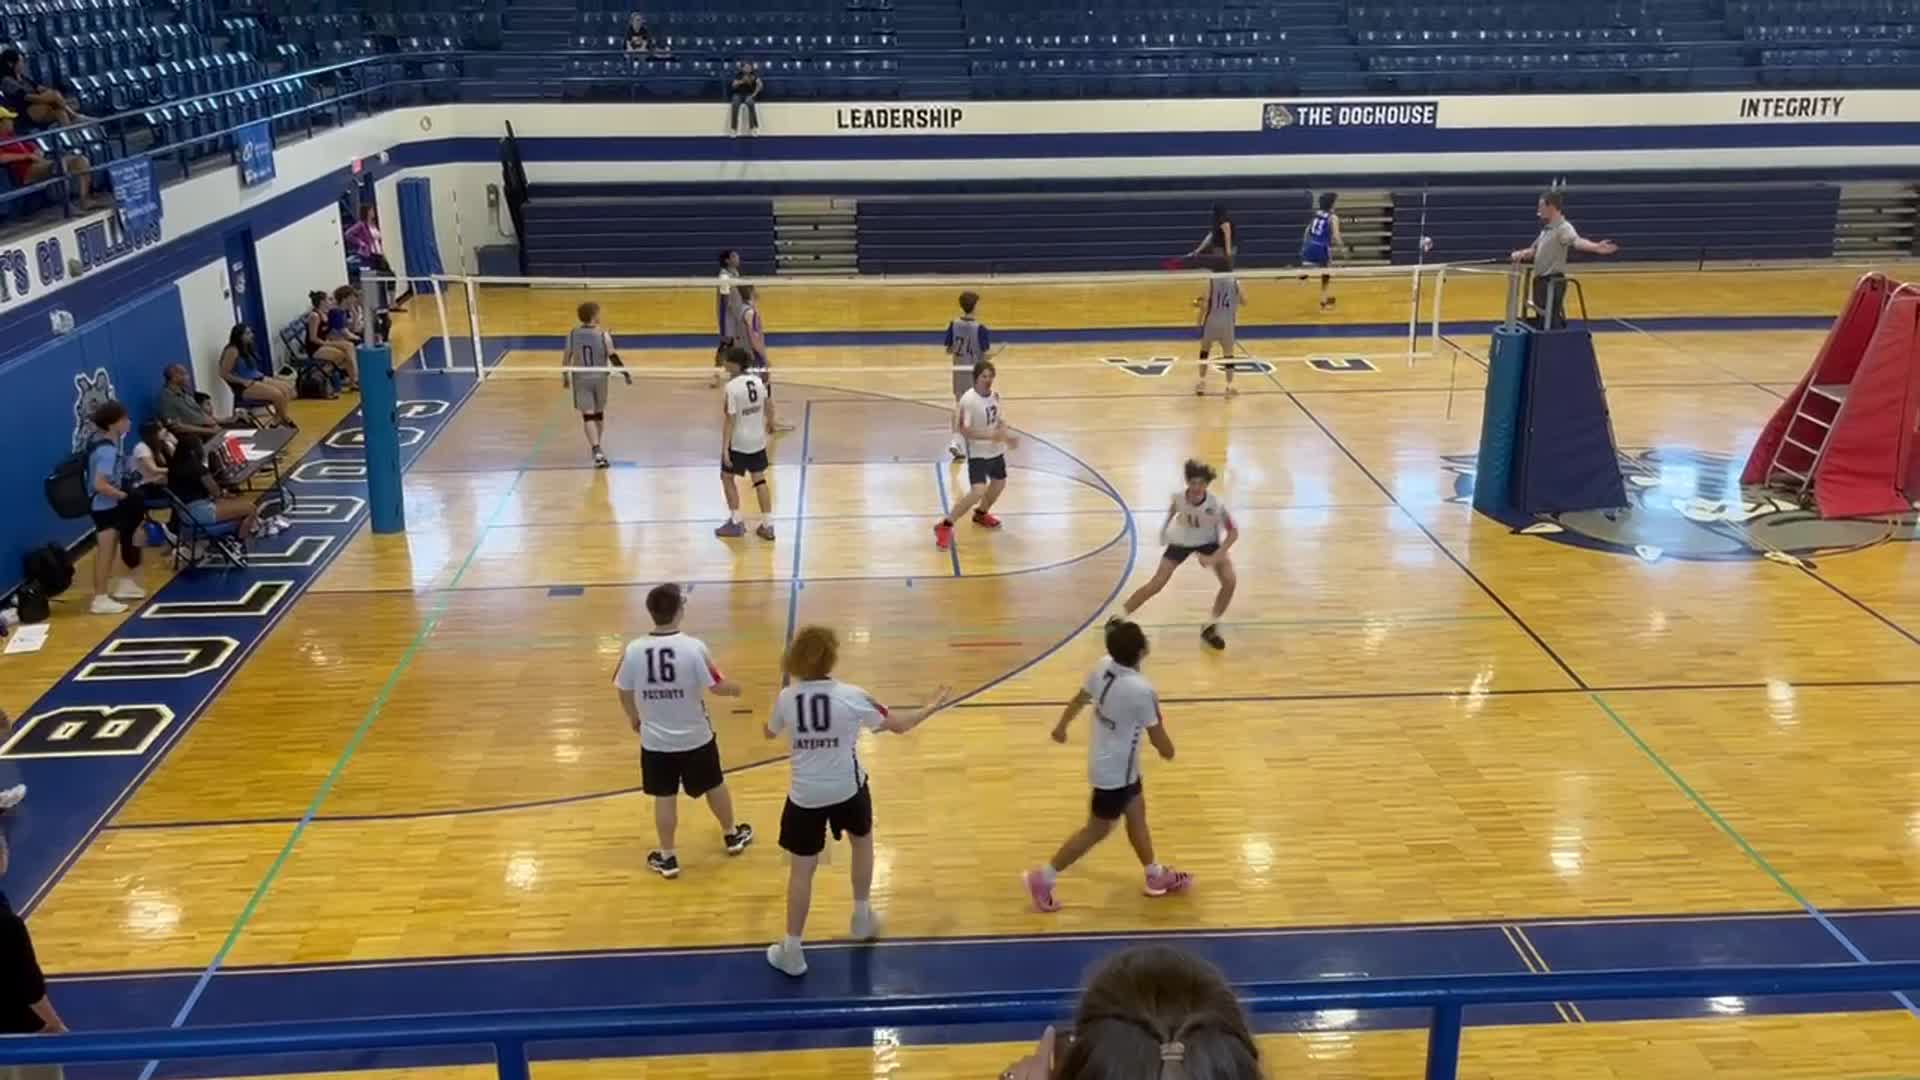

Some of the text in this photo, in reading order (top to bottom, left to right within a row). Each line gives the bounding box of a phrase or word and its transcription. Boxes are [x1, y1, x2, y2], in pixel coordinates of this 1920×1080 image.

[837, 108, 963, 128] LEADERSHIP
[1297, 104, 1435, 126] THE DOGHOUSE
[1739, 96, 1845, 118] INTEGRITY
[35, 236, 65, 286] GO
[75, 212, 162, 271] BULLS
[745, 380, 758, 403] 6
[645, 647, 676, 684] 16
[1099, 669, 1116, 705] 7
[796, 693, 831, 733] 10
